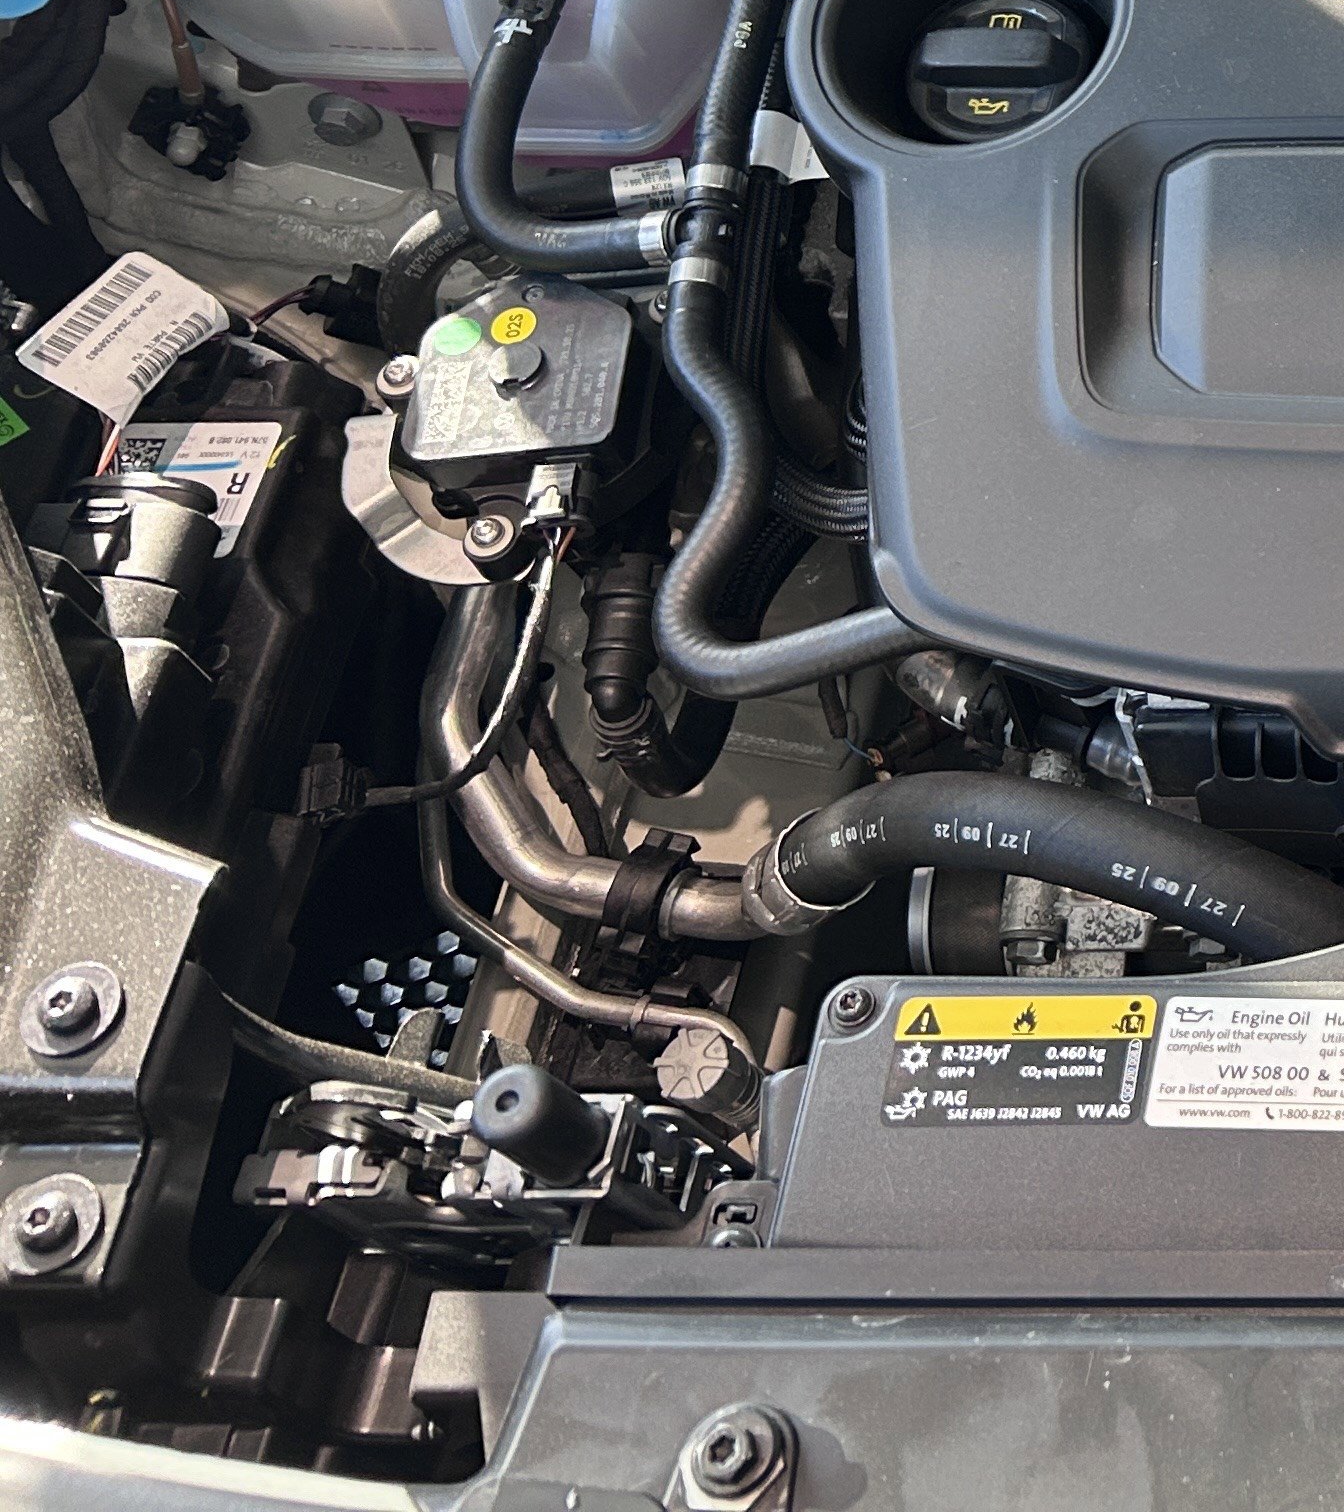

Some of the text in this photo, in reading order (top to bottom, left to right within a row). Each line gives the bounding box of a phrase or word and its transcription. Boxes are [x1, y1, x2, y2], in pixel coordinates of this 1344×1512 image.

[226, 473, 250, 494] R
[1231, 1010, 1311, 1028] Engine Oil
[1169, 1028, 1308, 1044] Use only oil that expressly
[941, 1043, 1106, 1064] R-1234yf 0.460 kg
[1167, 1042, 1242, 1055] complies with
[1319, 1047, 1337, 1058] qui
[937, 1066, 967, 1078] GWP
[967, 1067, 975, 1078] 4
[1218, 1064, 1248, 1079] VW
[1251, 1066, 1282, 1080] 508
[1287, 1066, 1310, 1080] 00
[1318, 1069, 1330, 1081] &
[1158, 1083, 1297, 1098] For a list of approved oils:
[1313, 1087, 1337, 1098] Pour
[932, 1090, 967, 1106] PAG
[947, 1108, 967, 1120] SAE
[970, 1108, 996, 1120] J639
[1076, 1104, 1131, 1118] VW AG
[1179, 1107, 1250, 1118] www.vw.com
